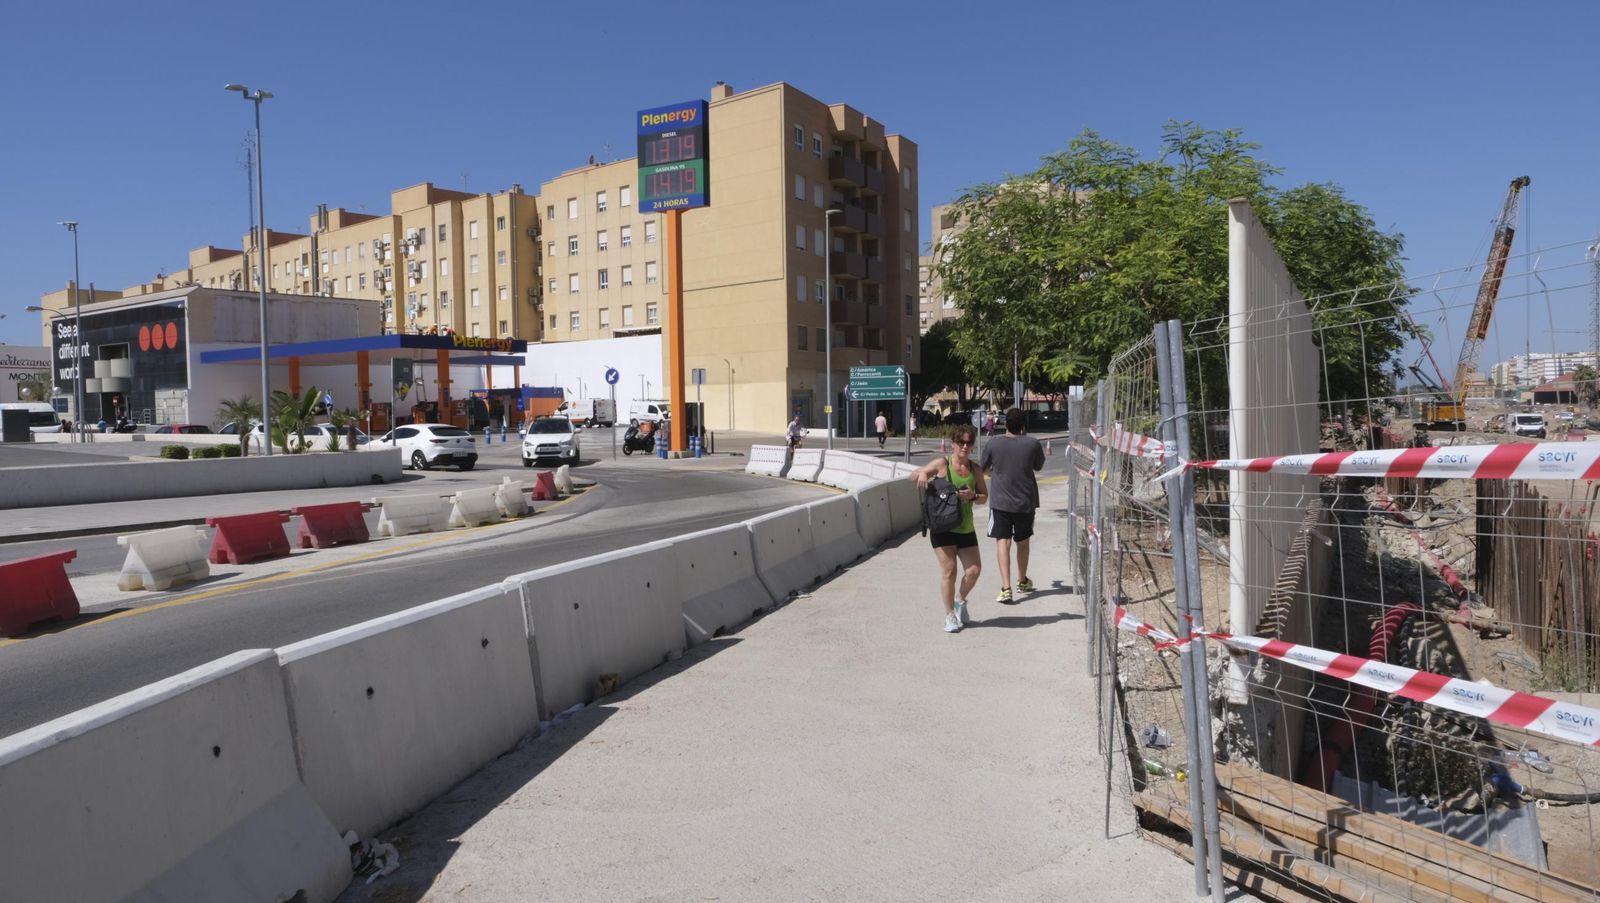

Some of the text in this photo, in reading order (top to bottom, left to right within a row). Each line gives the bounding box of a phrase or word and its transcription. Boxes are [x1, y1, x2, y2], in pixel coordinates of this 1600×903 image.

[642, 108, 697, 126] Plenergy
[655, 165, 678, 173] GASOLINA
[653, 198, 689, 209] 24 HORAS
[57, 323, 79, 339] See a
[58, 342, 90, 359] differnt
[453, 335, 513, 352] Plenergy
